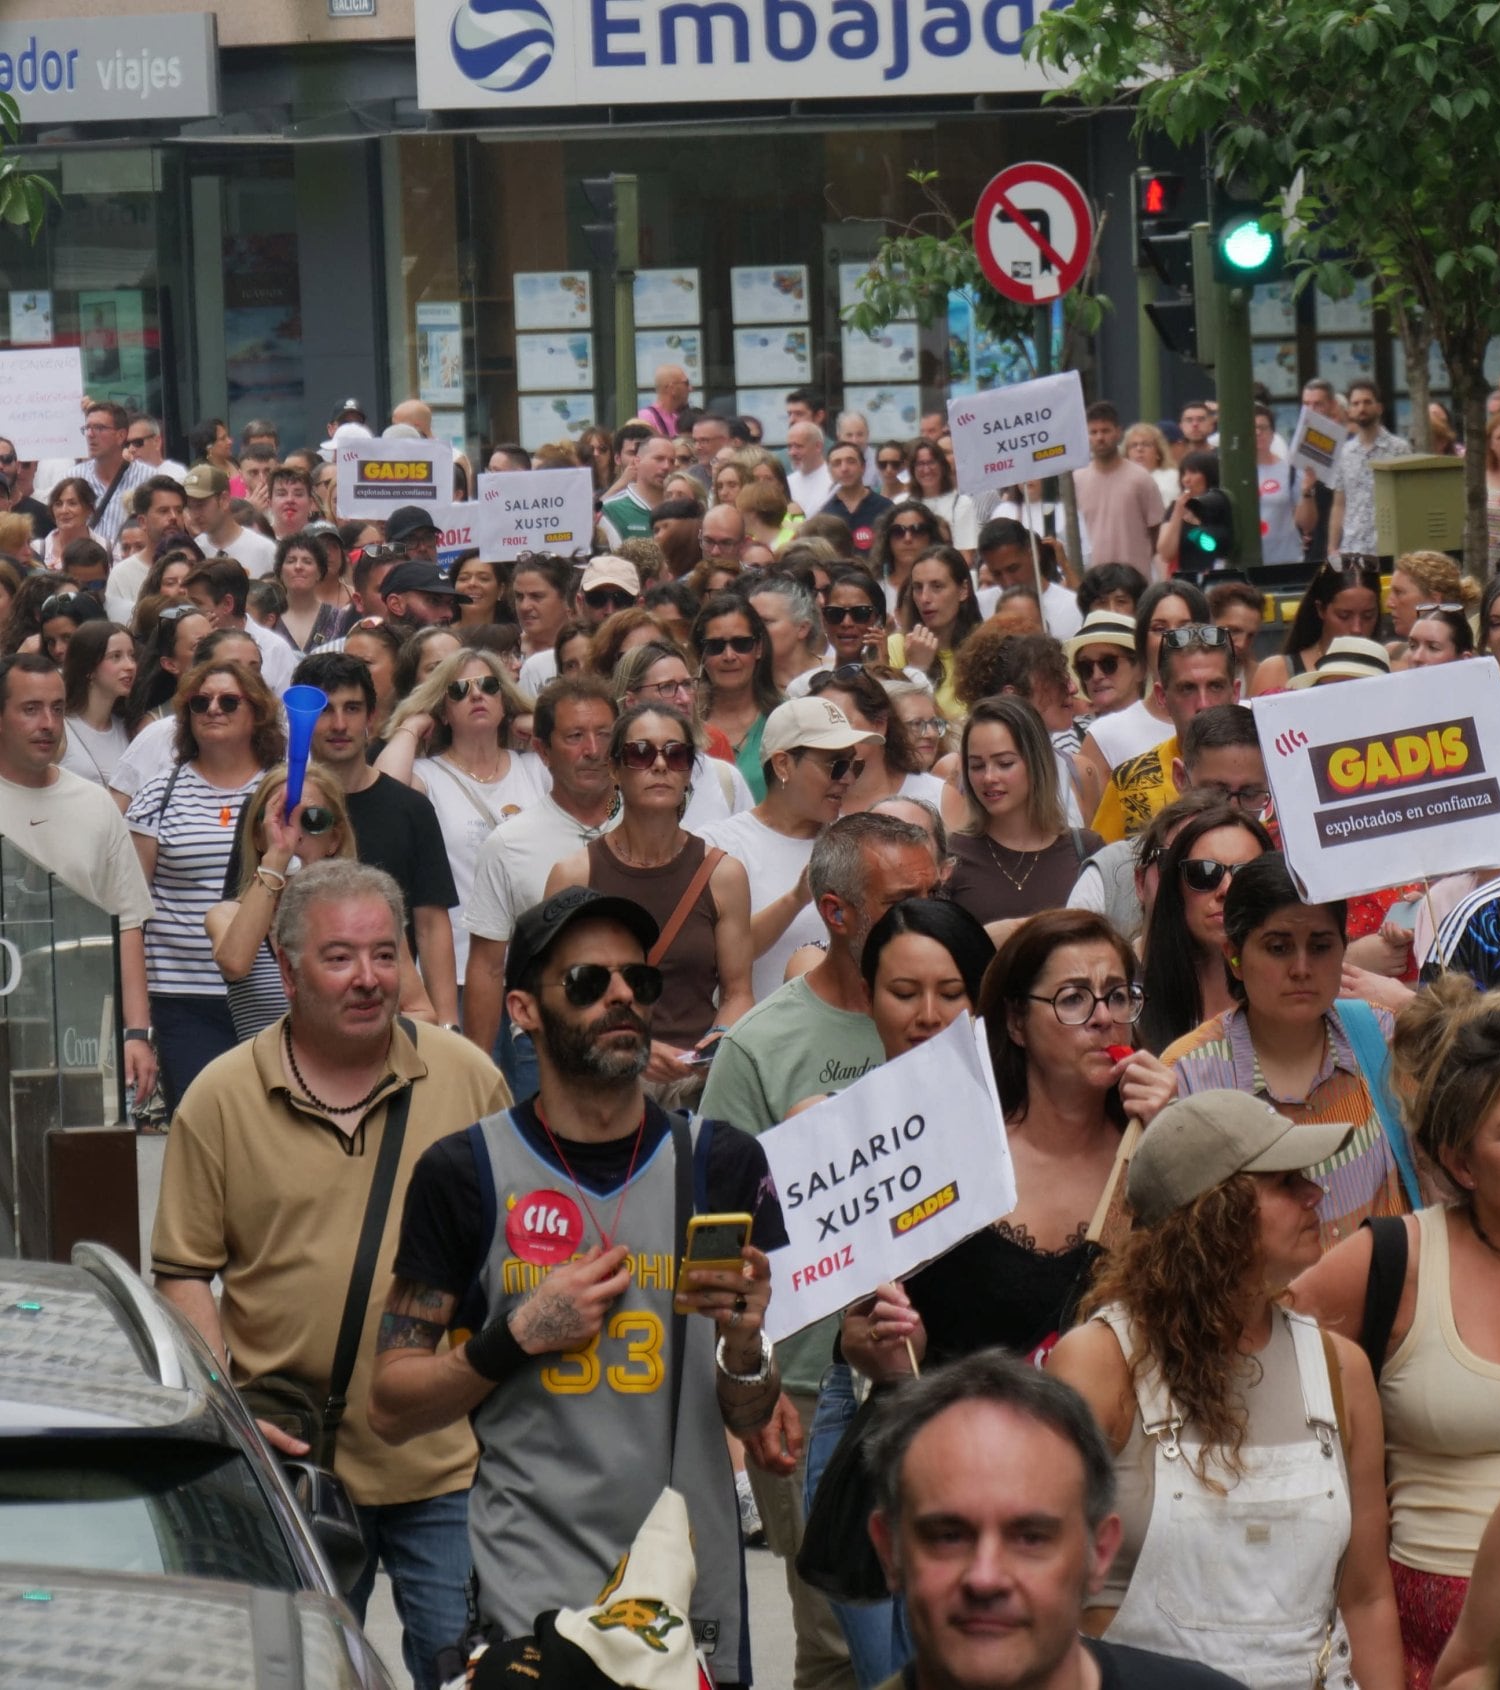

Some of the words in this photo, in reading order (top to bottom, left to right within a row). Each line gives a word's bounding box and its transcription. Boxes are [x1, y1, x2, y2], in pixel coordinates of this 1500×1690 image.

[591, 0, 1076, 80] Embajad
[97, 50, 181, 98] viajes
[983, 408, 1052, 435] SALARIO
[997, 431, 1049, 454] XUSTO
[364, 462, 428, 481] GADIS
[984, 459, 1015, 474] FROIZ
[504, 497, 564, 512] SALARIO
[515, 516, 560, 530] XUSTO
[435, 527, 471, 547] ROIZ
[502, 536, 528, 547] FROIZ
[1327, 727, 1469, 794] GADIS
[1325, 809, 1402, 836] explotados
[1407, 805, 1424, 819] en
[1426, 792, 1492, 816] confianza
[64, 1027, 99, 1066] Com
[786, 1114, 925, 1209] SALARIO
[816, 1165, 922, 1242] XUSTO
[791, 1245, 854, 1292] FROIZ
[896, 1185, 956, 1233] GADIS
[541, 1311, 665, 1394] 33
